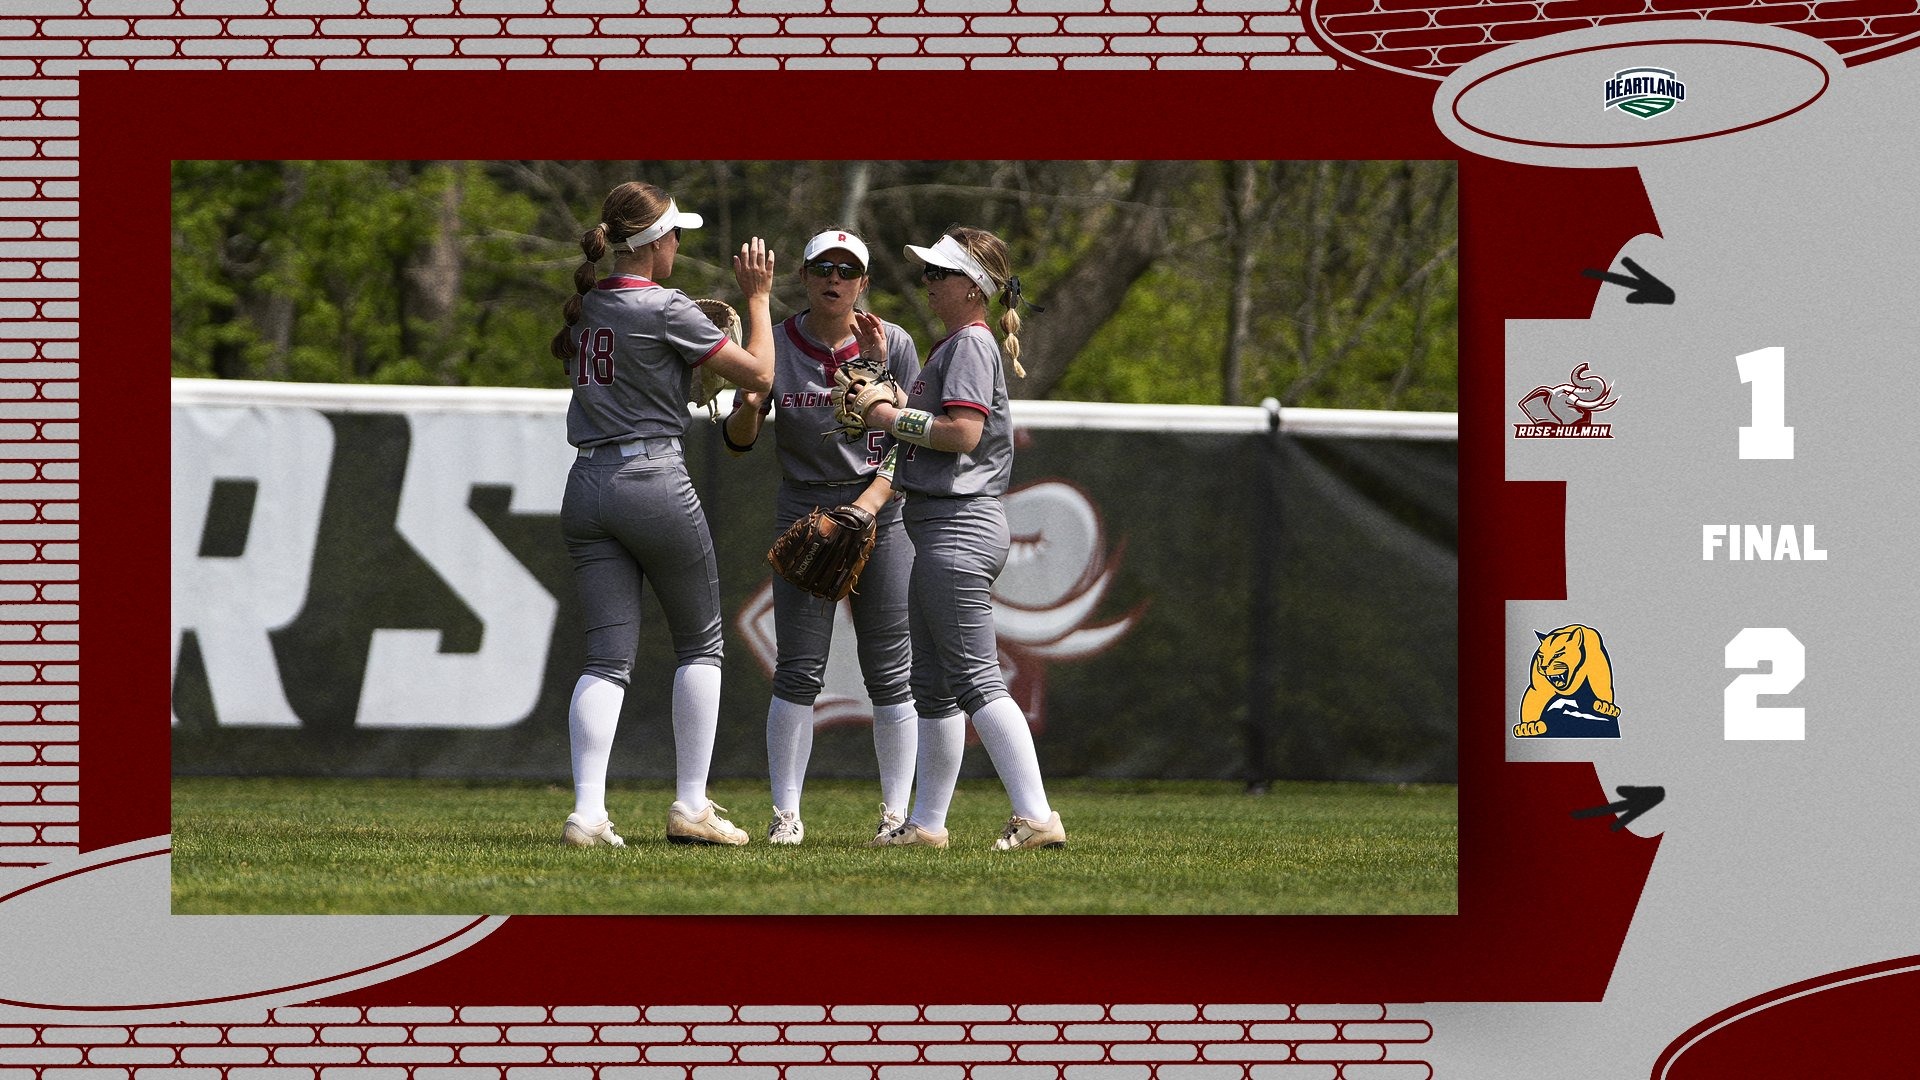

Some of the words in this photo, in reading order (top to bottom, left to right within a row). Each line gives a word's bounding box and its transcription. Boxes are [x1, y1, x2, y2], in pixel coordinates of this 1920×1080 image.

[838, 233, 846, 242] R
[577, 327, 615, 386] 18
[781, 391, 835, 408] ENGIN
[866, 430, 885, 467] 5
[795, 542, 820, 577] NOKONA
